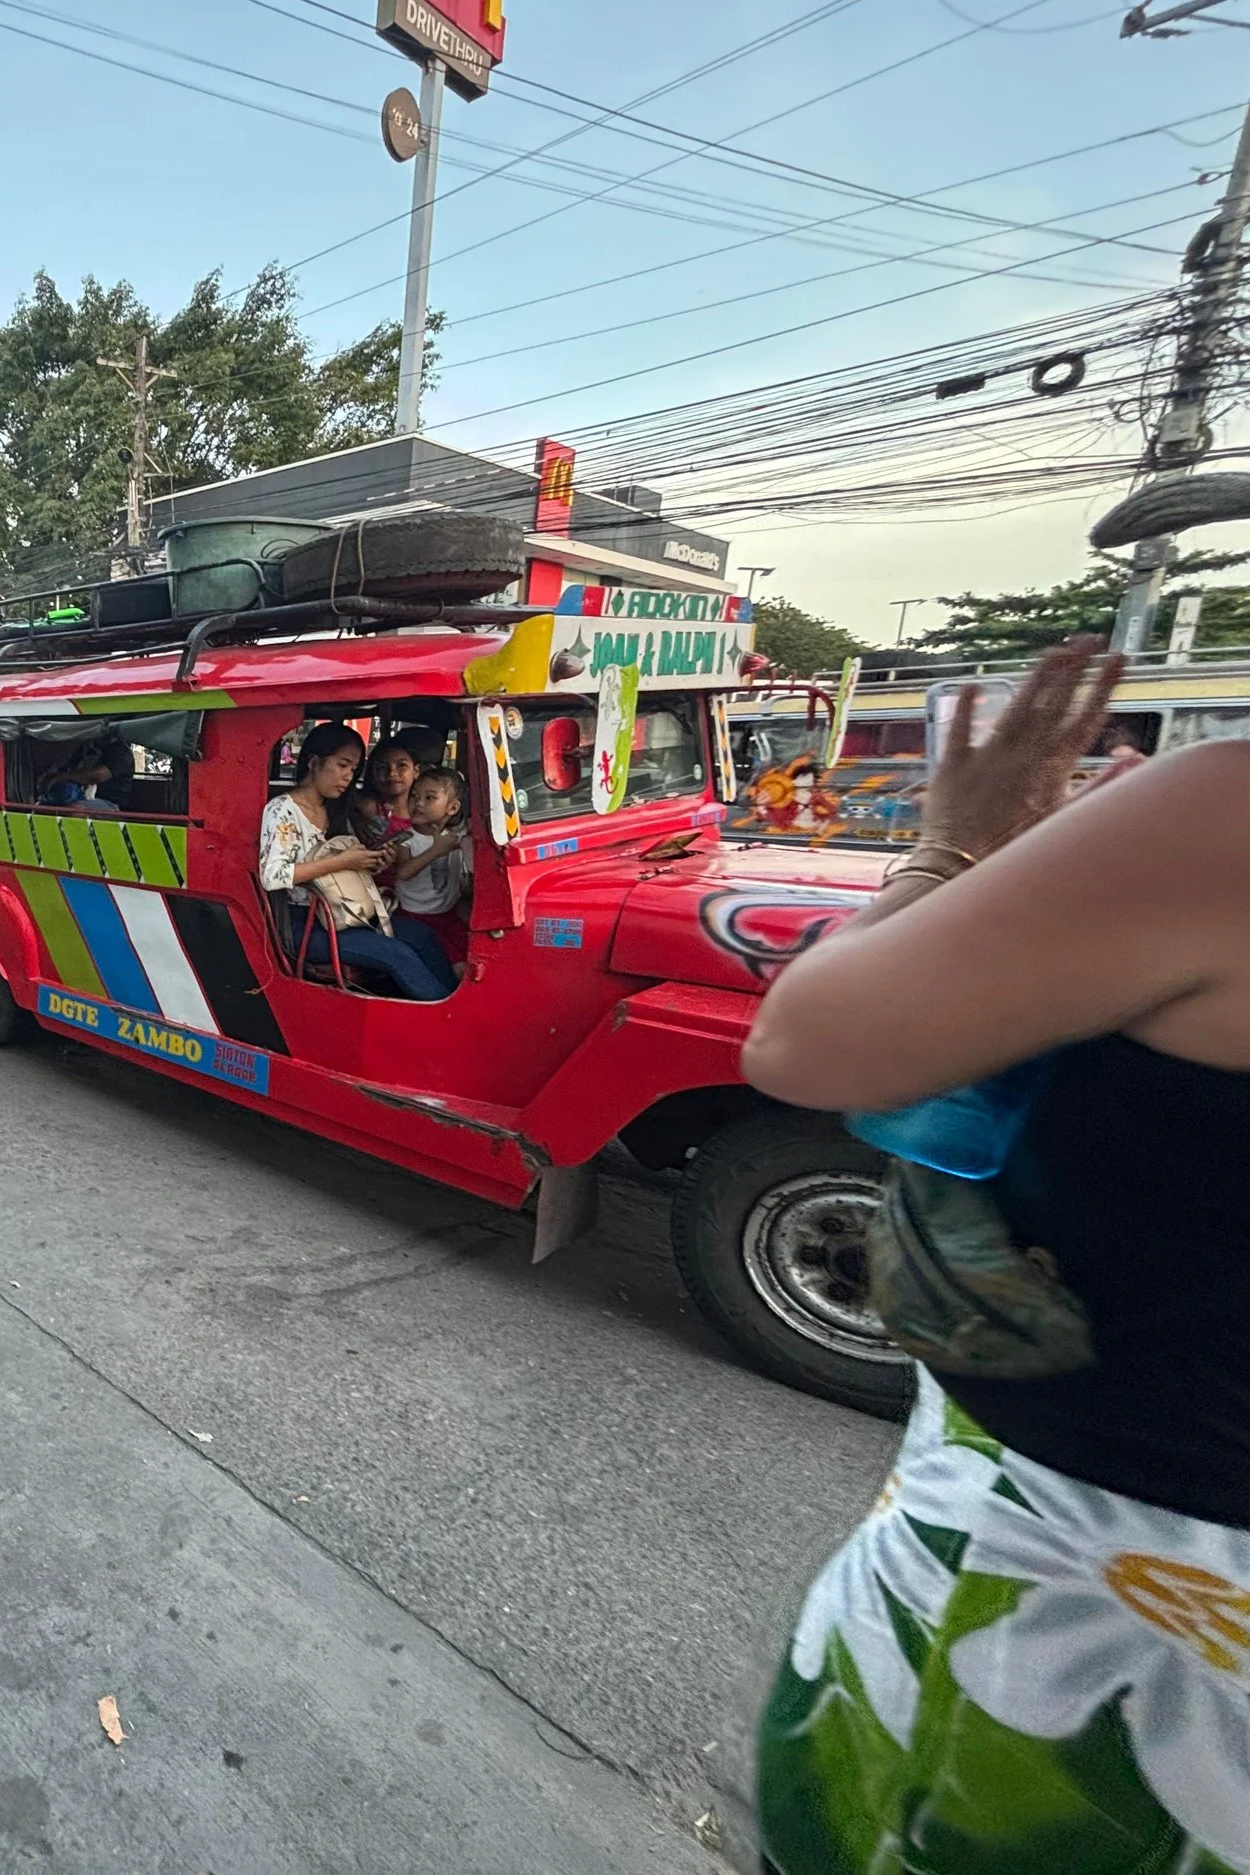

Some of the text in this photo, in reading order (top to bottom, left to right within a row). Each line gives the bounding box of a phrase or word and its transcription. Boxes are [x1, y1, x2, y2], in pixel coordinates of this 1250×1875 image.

[663, 541, 719, 571] McDonald's
[49, 993, 202, 1062] DGTE ZAMBO
